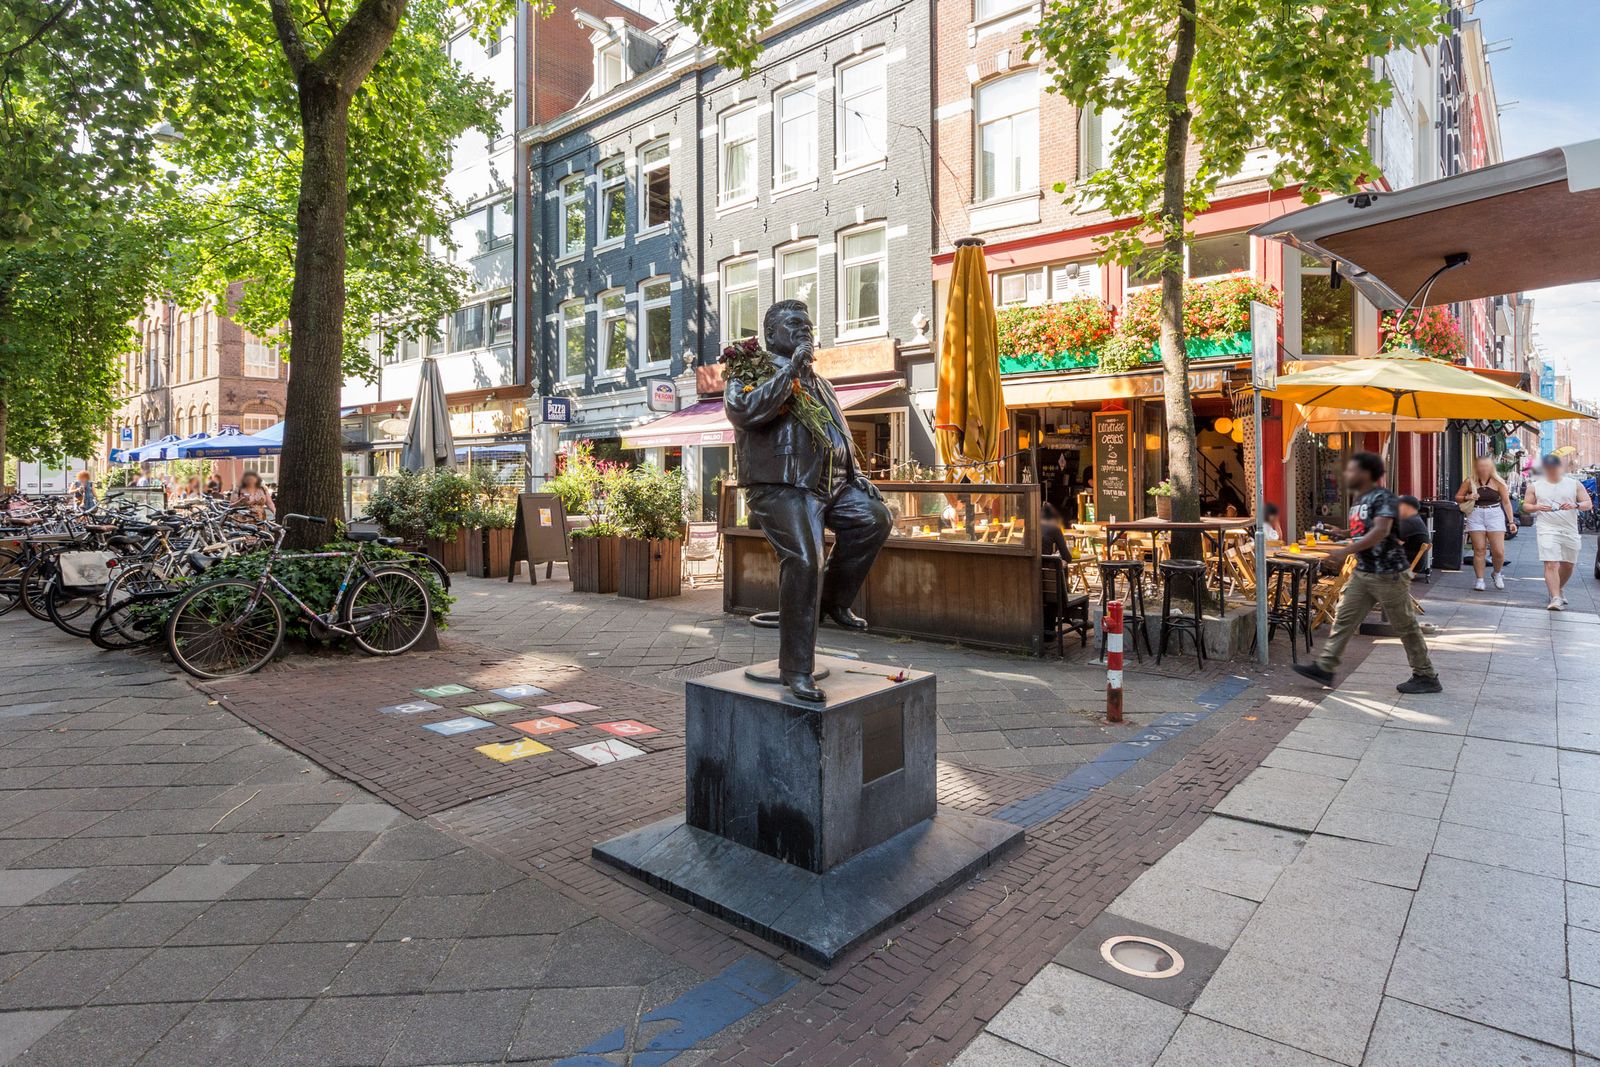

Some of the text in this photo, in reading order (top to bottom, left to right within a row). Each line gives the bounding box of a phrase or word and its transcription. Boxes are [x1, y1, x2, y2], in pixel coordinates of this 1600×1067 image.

[124, 428, 131, 437] P
[419, 685, 464, 696] 10
[505, 686, 529, 696] 9
[445, 719, 475, 729] 5
[534, 718, 561, 730] 4
[498, 742, 532, 757] 2
